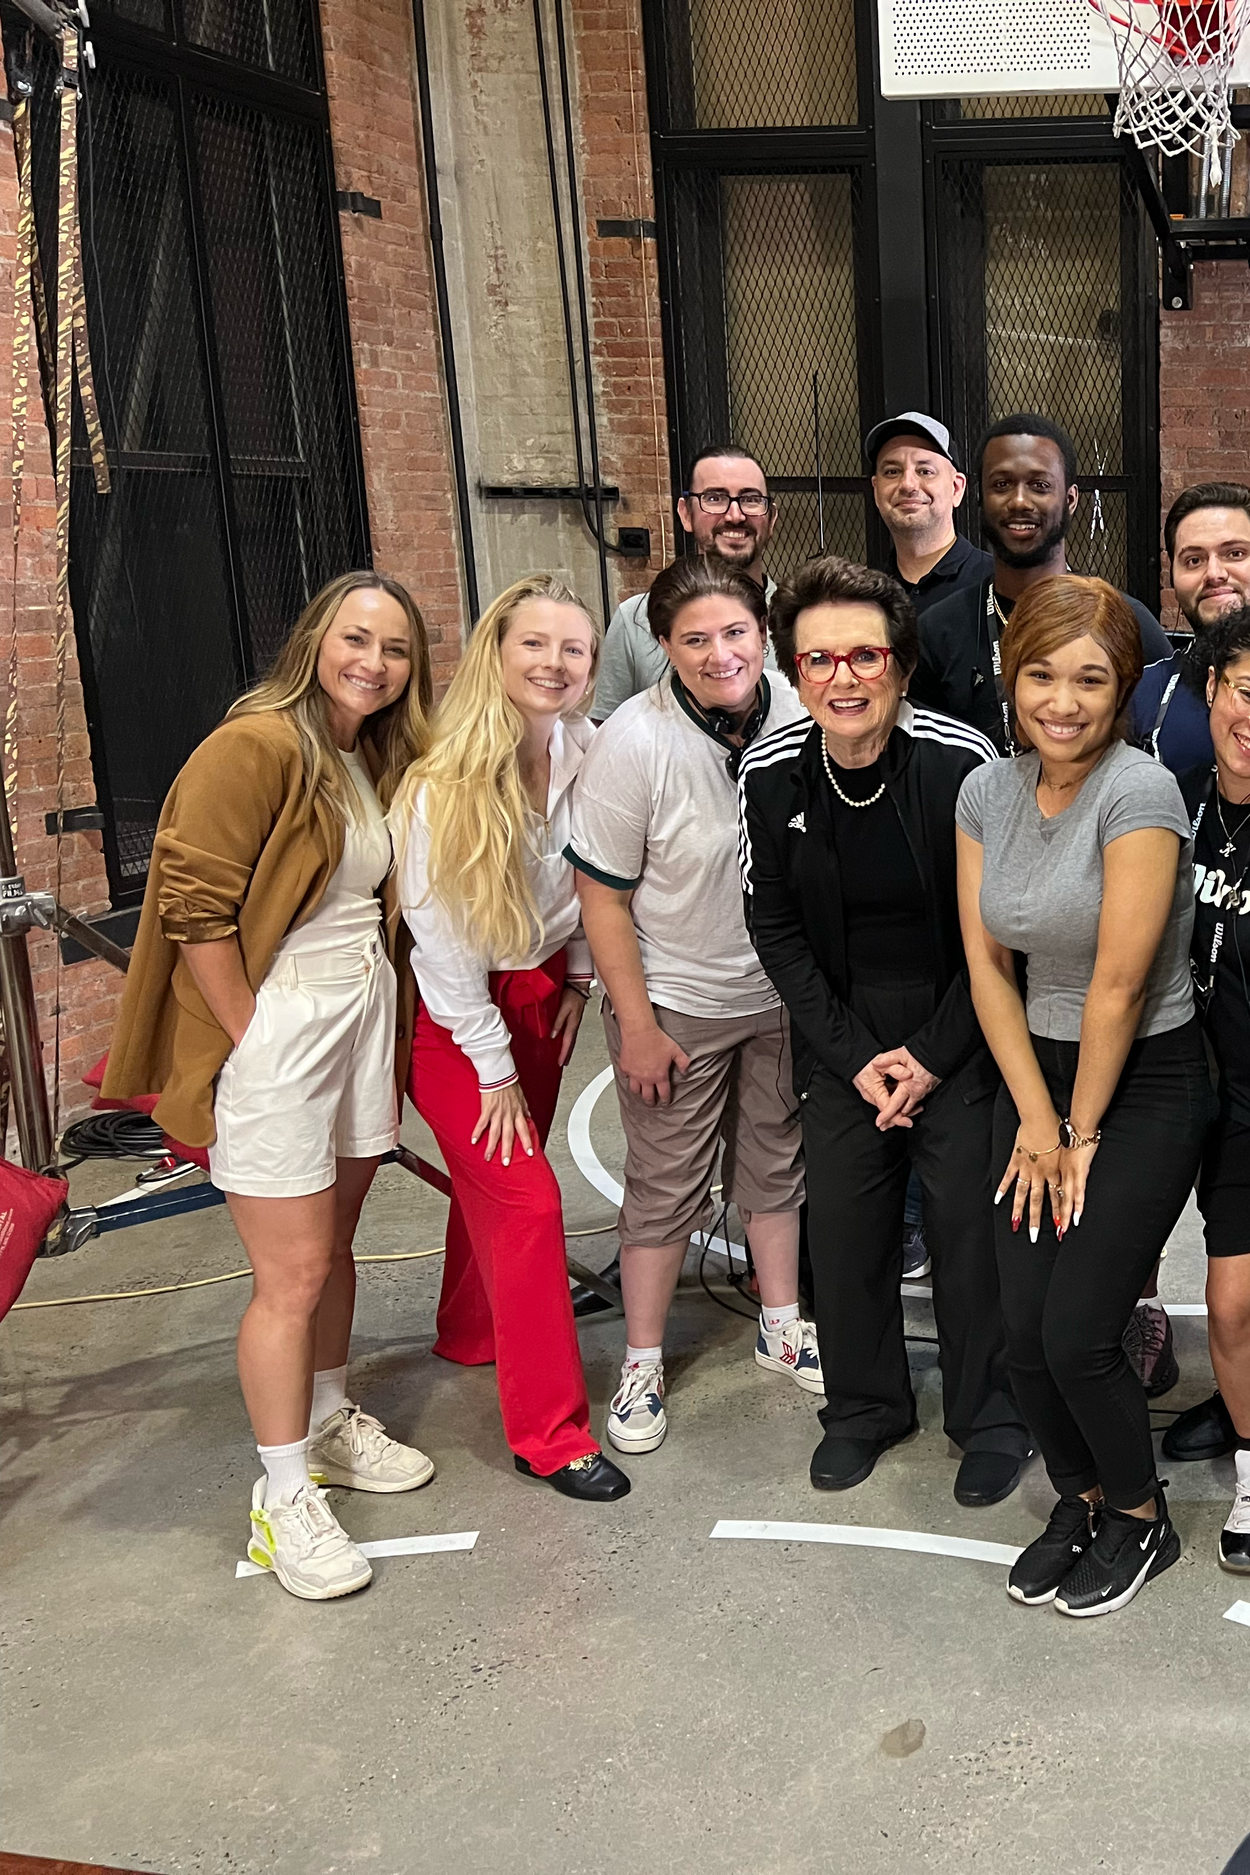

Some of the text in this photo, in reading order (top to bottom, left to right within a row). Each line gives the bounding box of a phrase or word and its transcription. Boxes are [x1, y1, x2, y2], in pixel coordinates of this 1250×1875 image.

[991, 640, 1002, 676] Wilson
[1161, 673, 1180, 705] Wilson
[1210, 922, 1224, 963] Wilson
